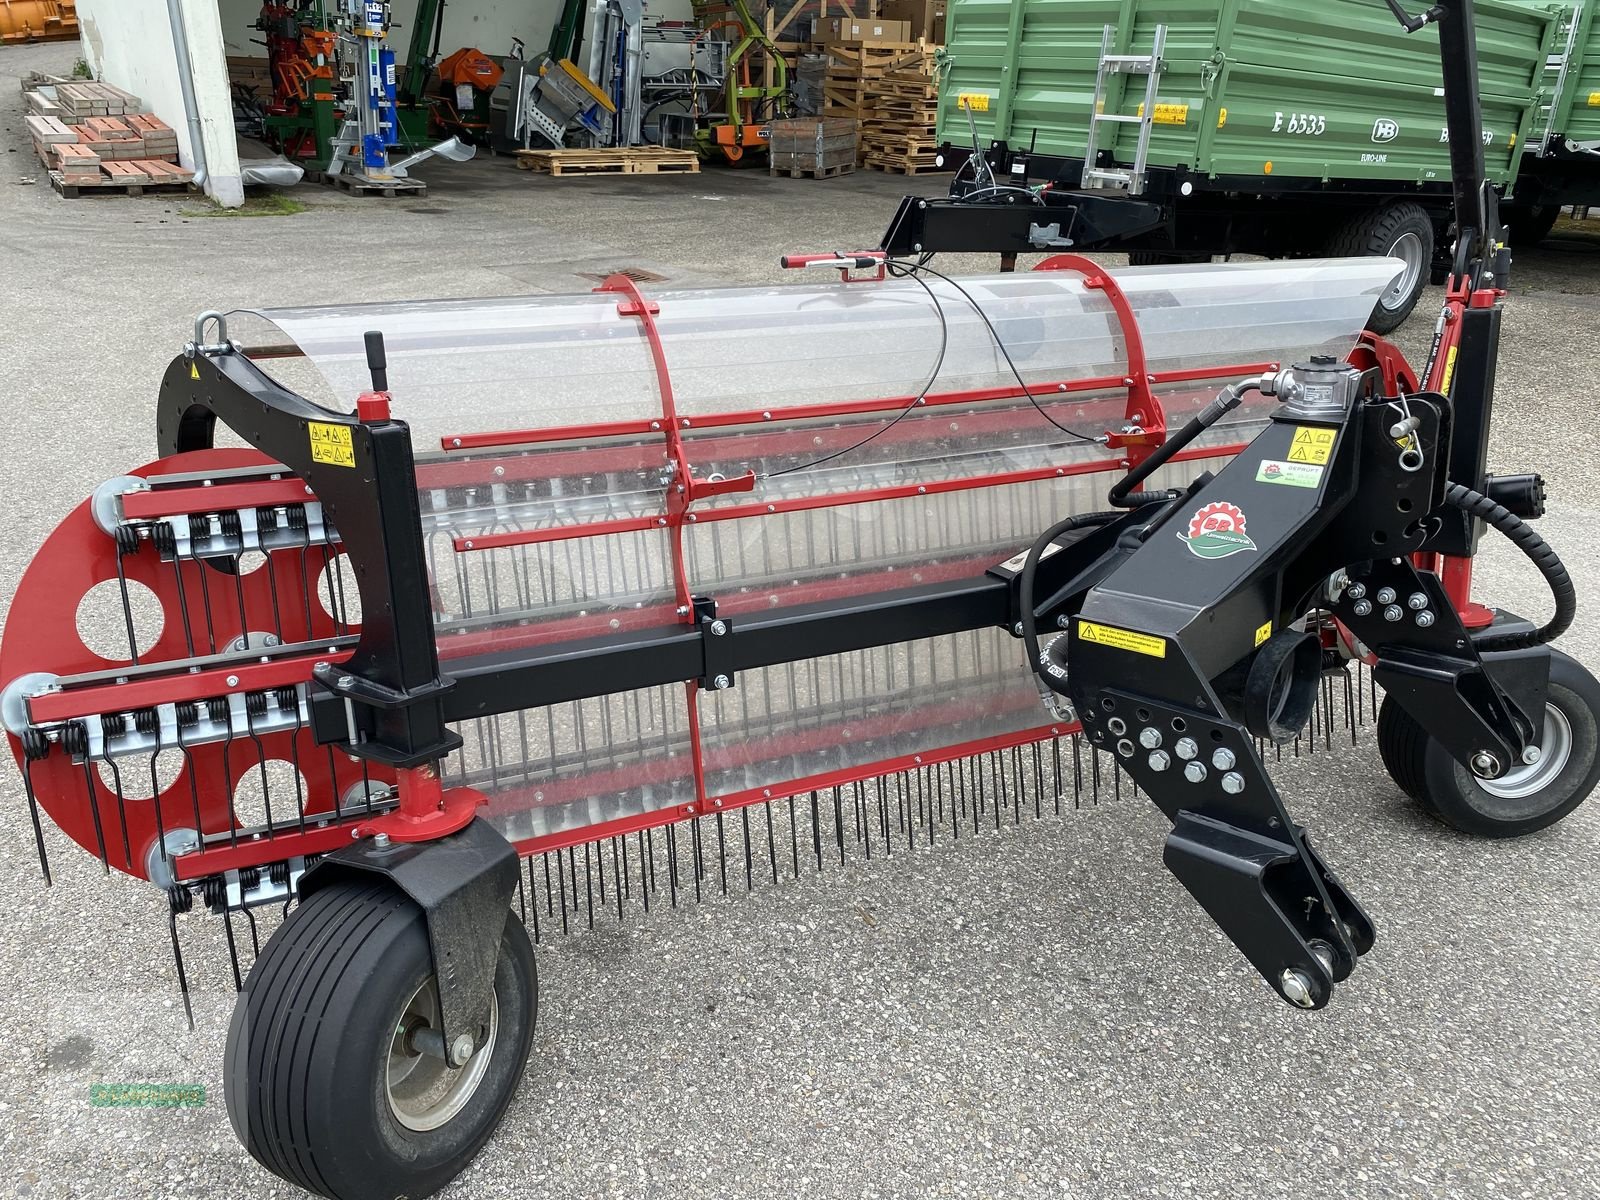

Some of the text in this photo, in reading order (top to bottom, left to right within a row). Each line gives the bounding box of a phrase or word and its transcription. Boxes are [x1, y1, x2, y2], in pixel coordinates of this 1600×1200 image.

[1272, 112, 1325, 135] E 6535
[1360, 153, 1387, 162] EURO-LINE
[1204, 517, 1232, 532] BB
